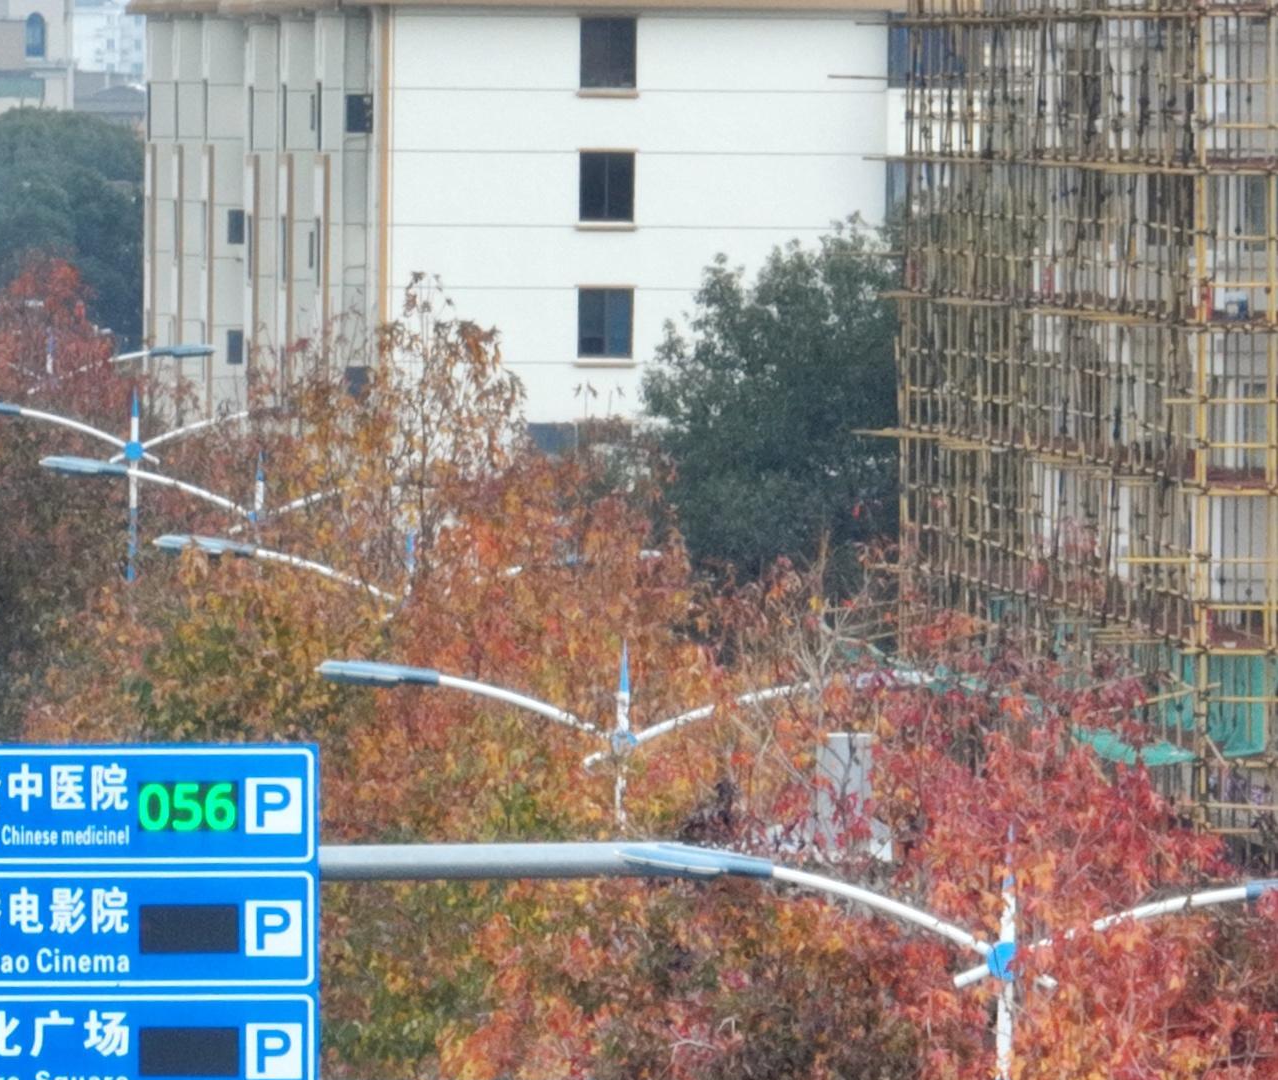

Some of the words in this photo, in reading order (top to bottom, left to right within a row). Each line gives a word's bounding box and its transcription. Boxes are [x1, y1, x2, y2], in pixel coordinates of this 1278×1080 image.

[138, 782, 237, 832] 056
[255, 784, 291, 827] P
[1, 824, 58, 846] Chinese
[61, 825, 130, 846] medicinel
[255, 907, 291, 950] P
[36, 948, 130, 973] Cinema
[255, 1030, 291, 1073] P
